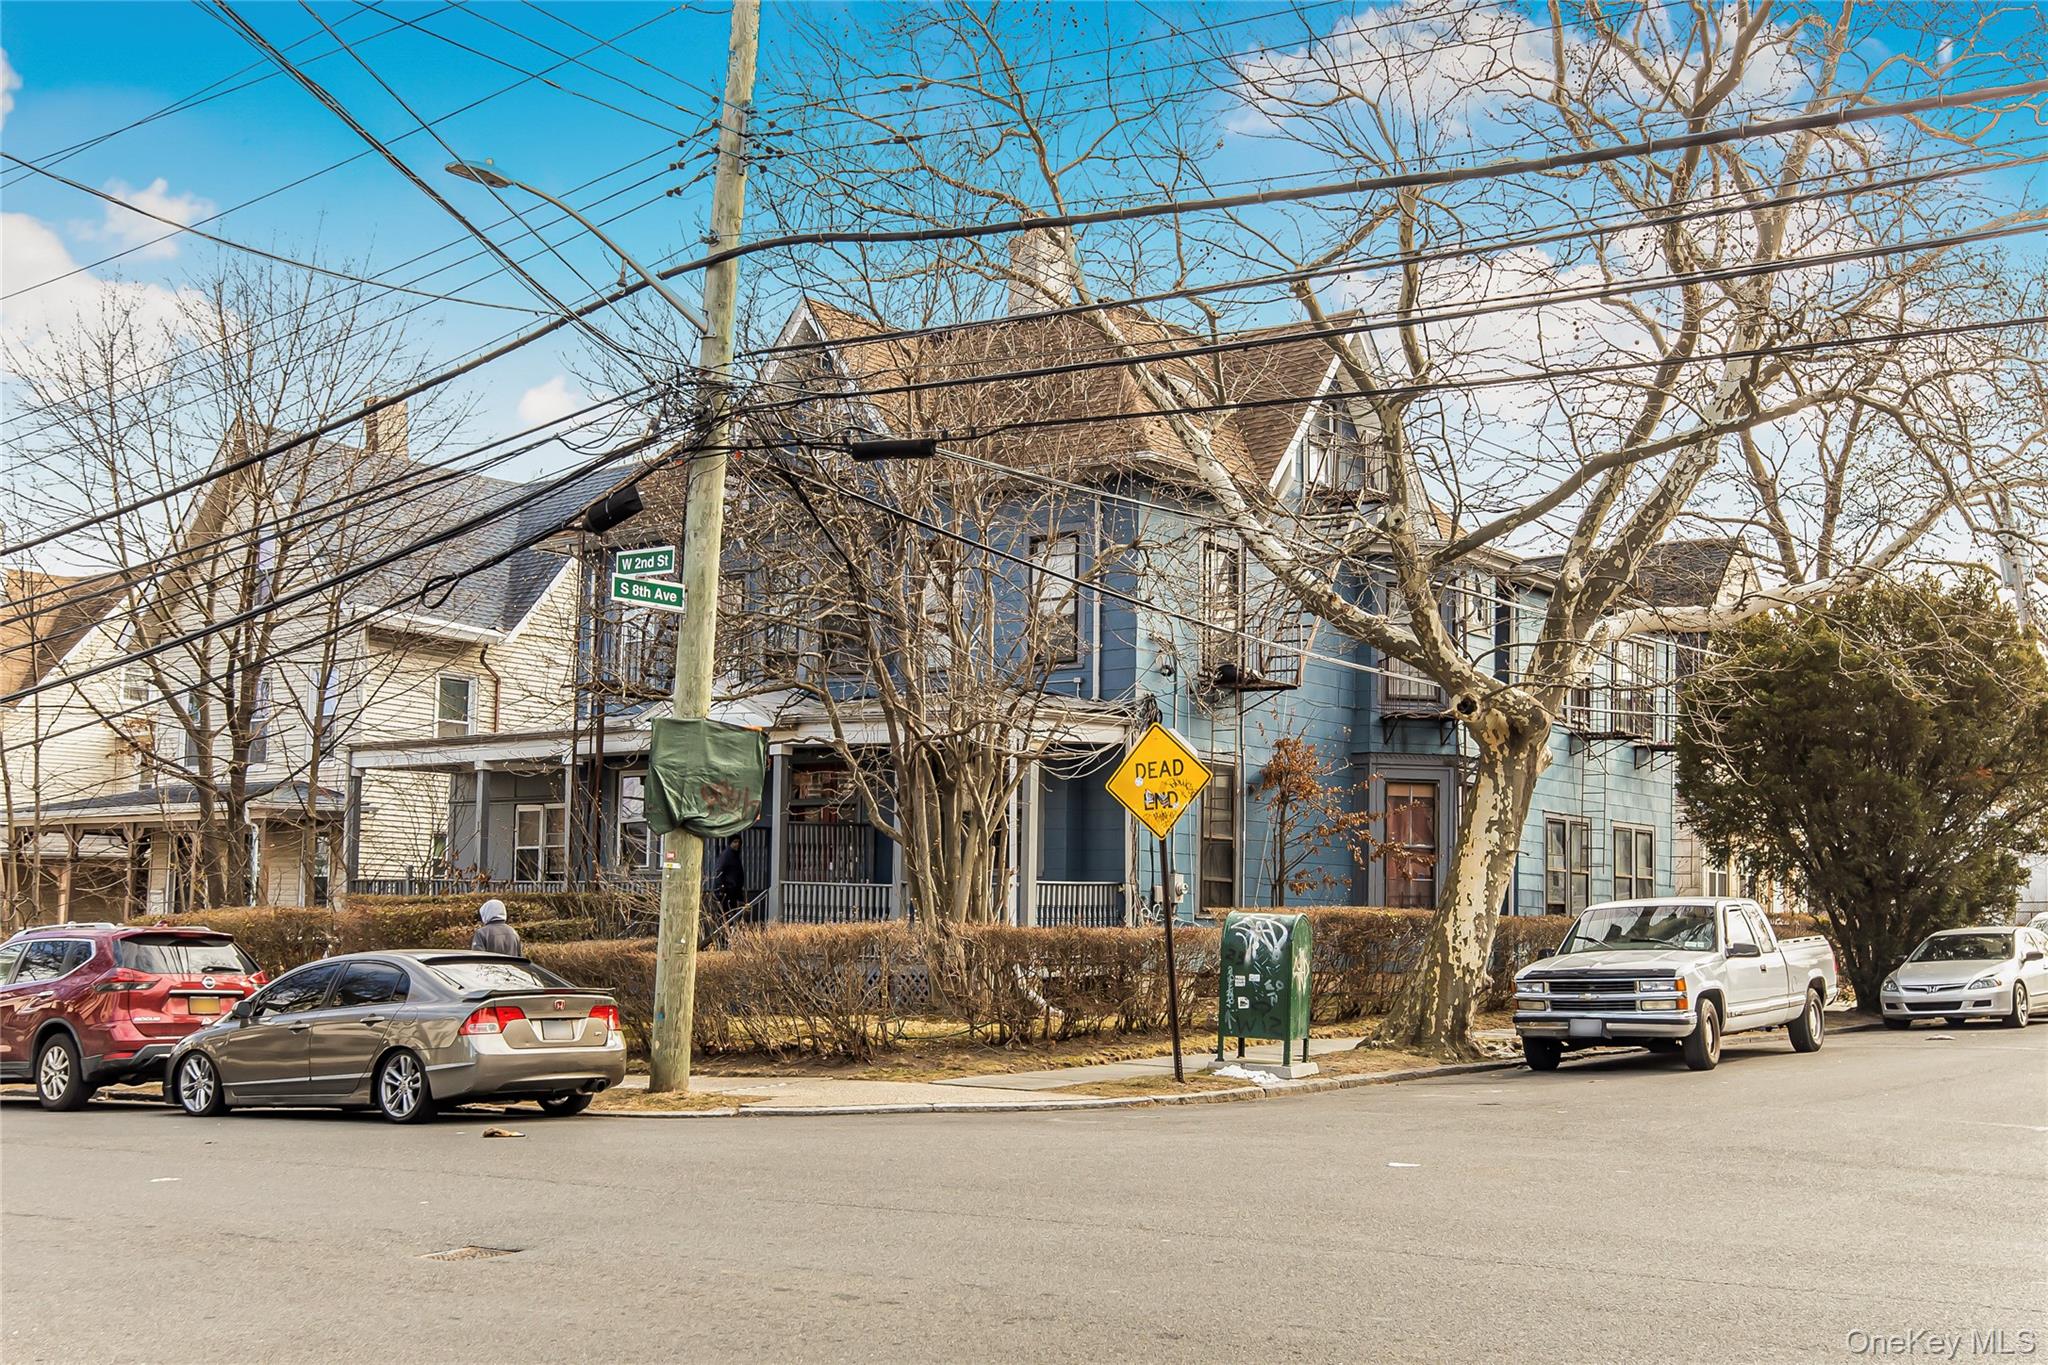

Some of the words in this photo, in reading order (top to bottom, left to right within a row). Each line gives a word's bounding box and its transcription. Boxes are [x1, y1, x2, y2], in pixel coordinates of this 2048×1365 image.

[621, 558, 632, 570] W
[634, 556, 654, 570] 2nd
[657, 554, 669, 567] St
[620, 582, 629, 595] S
[632, 584, 651, 598] 8th
[654, 588, 677, 602] Ave
[1135, 759, 1184, 779] DEAD
[1144, 790, 1178, 811] END
